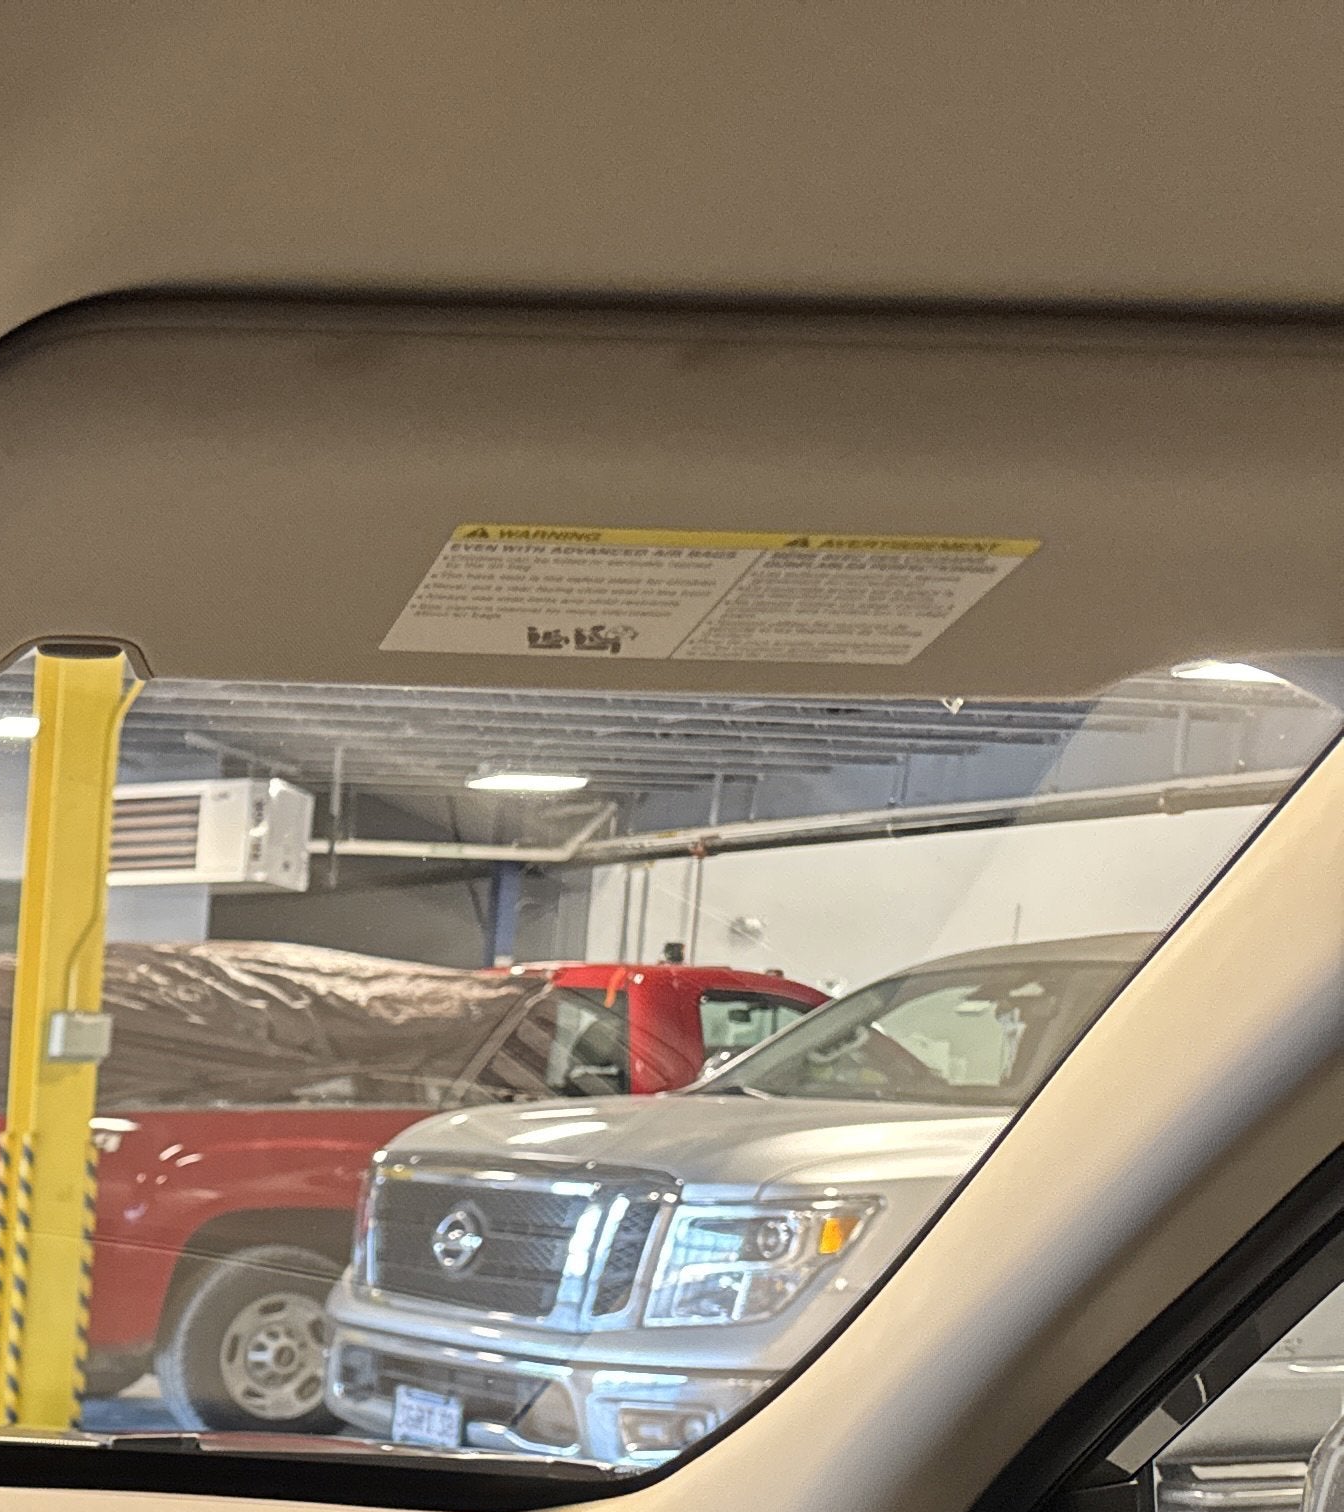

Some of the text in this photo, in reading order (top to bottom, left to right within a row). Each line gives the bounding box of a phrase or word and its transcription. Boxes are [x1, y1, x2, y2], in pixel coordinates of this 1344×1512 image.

[498, 528, 602, 542] WARNING
[450, 543, 498, 554] EVEN
[502, 544, 546, 554] WITH
